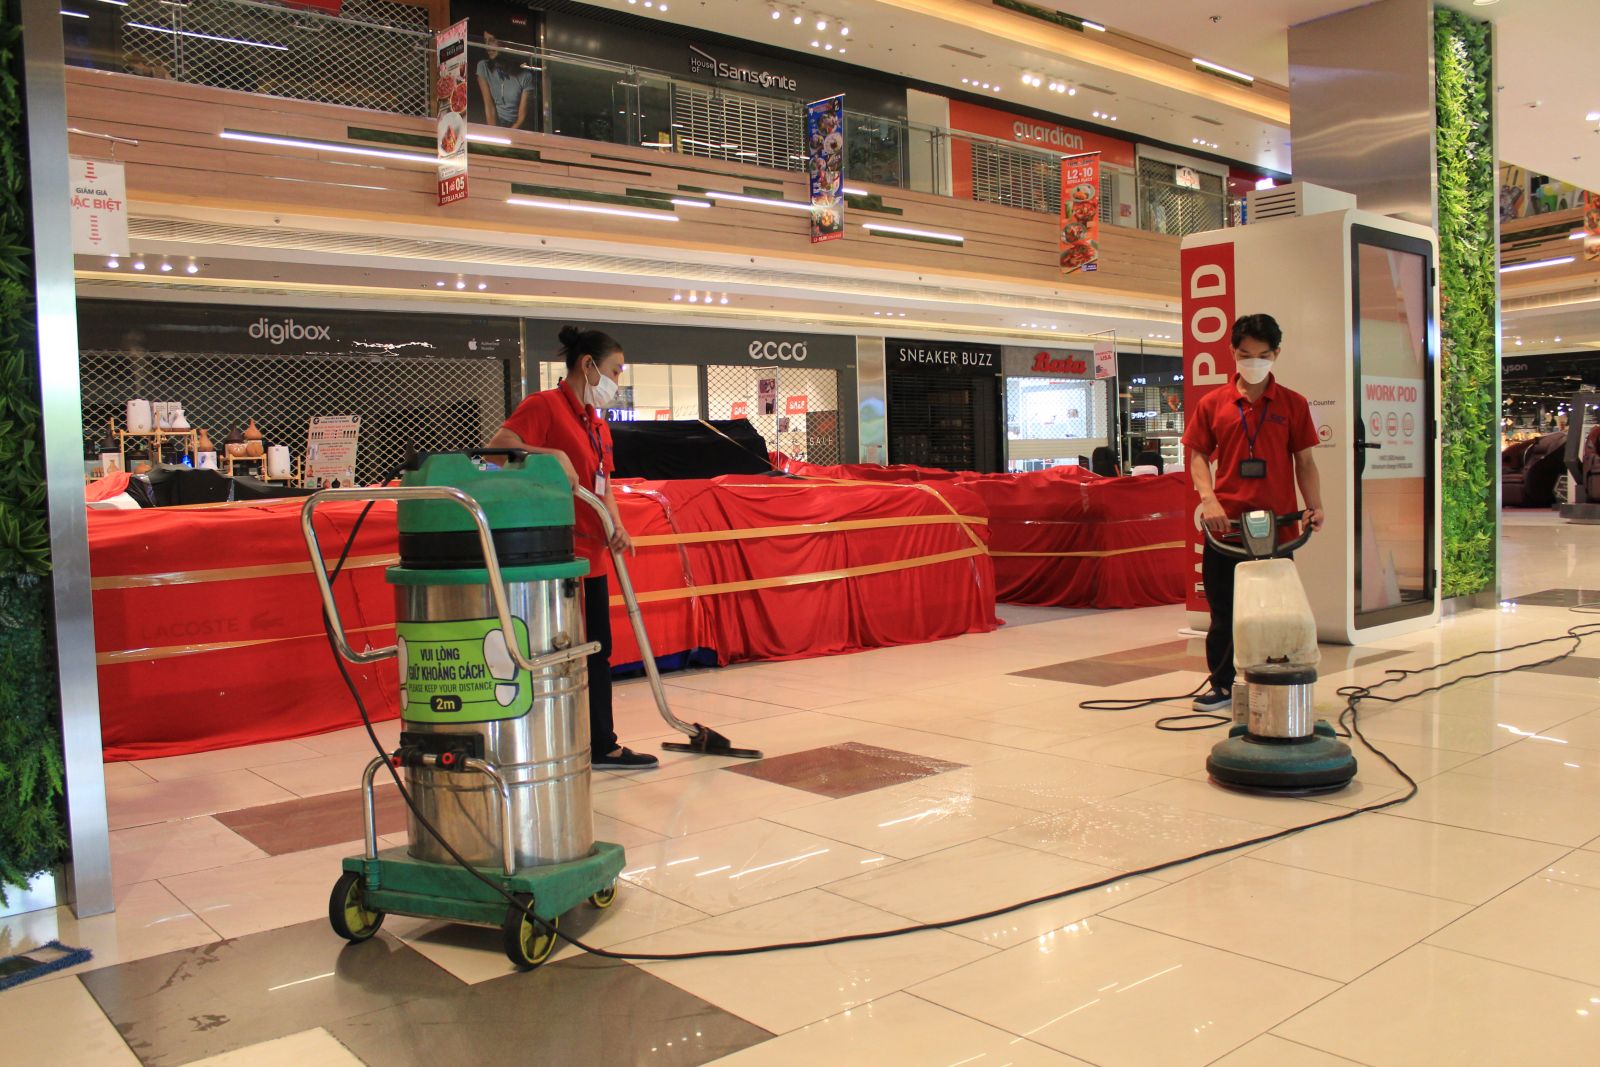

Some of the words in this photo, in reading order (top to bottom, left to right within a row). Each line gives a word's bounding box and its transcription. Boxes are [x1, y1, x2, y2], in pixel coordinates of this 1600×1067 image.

[691, 57, 714, 69] House
[719, 63, 797, 91] Samsonite
[1013, 121, 1084, 150] guardian
[1066, 167, 1093, 180] L2-10
[93, 198, 122, 212] BIỆT
[249, 318, 331, 345] digibox
[1190, 264, 1228, 387] POD
[748, 341, 807, 361] ecco
[900, 348, 957, 364] SNEAKER
[962, 352, 993, 366] BUZZ
[1031, 352, 1087, 374] Bata
[1502, 363, 1528, 375] yson
[1366, 384, 1395, 401] WORK
[1397, 386, 1417, 403] POD
[420, 648, 433, 661] VUI
[436, 646, 460, 661] LÒNG
[422, 662, 456, 680] KHOẢNG
[459, 661, 485, 679] CÁCH
[408, 684, 423, 692] PLEASE
[424, 684, 437, 692] KEEP
[439, 683, 457, 692] YOUR
[459, 681, 492, 692] DISTANCE
[436, 698, 455, 710] 2m
